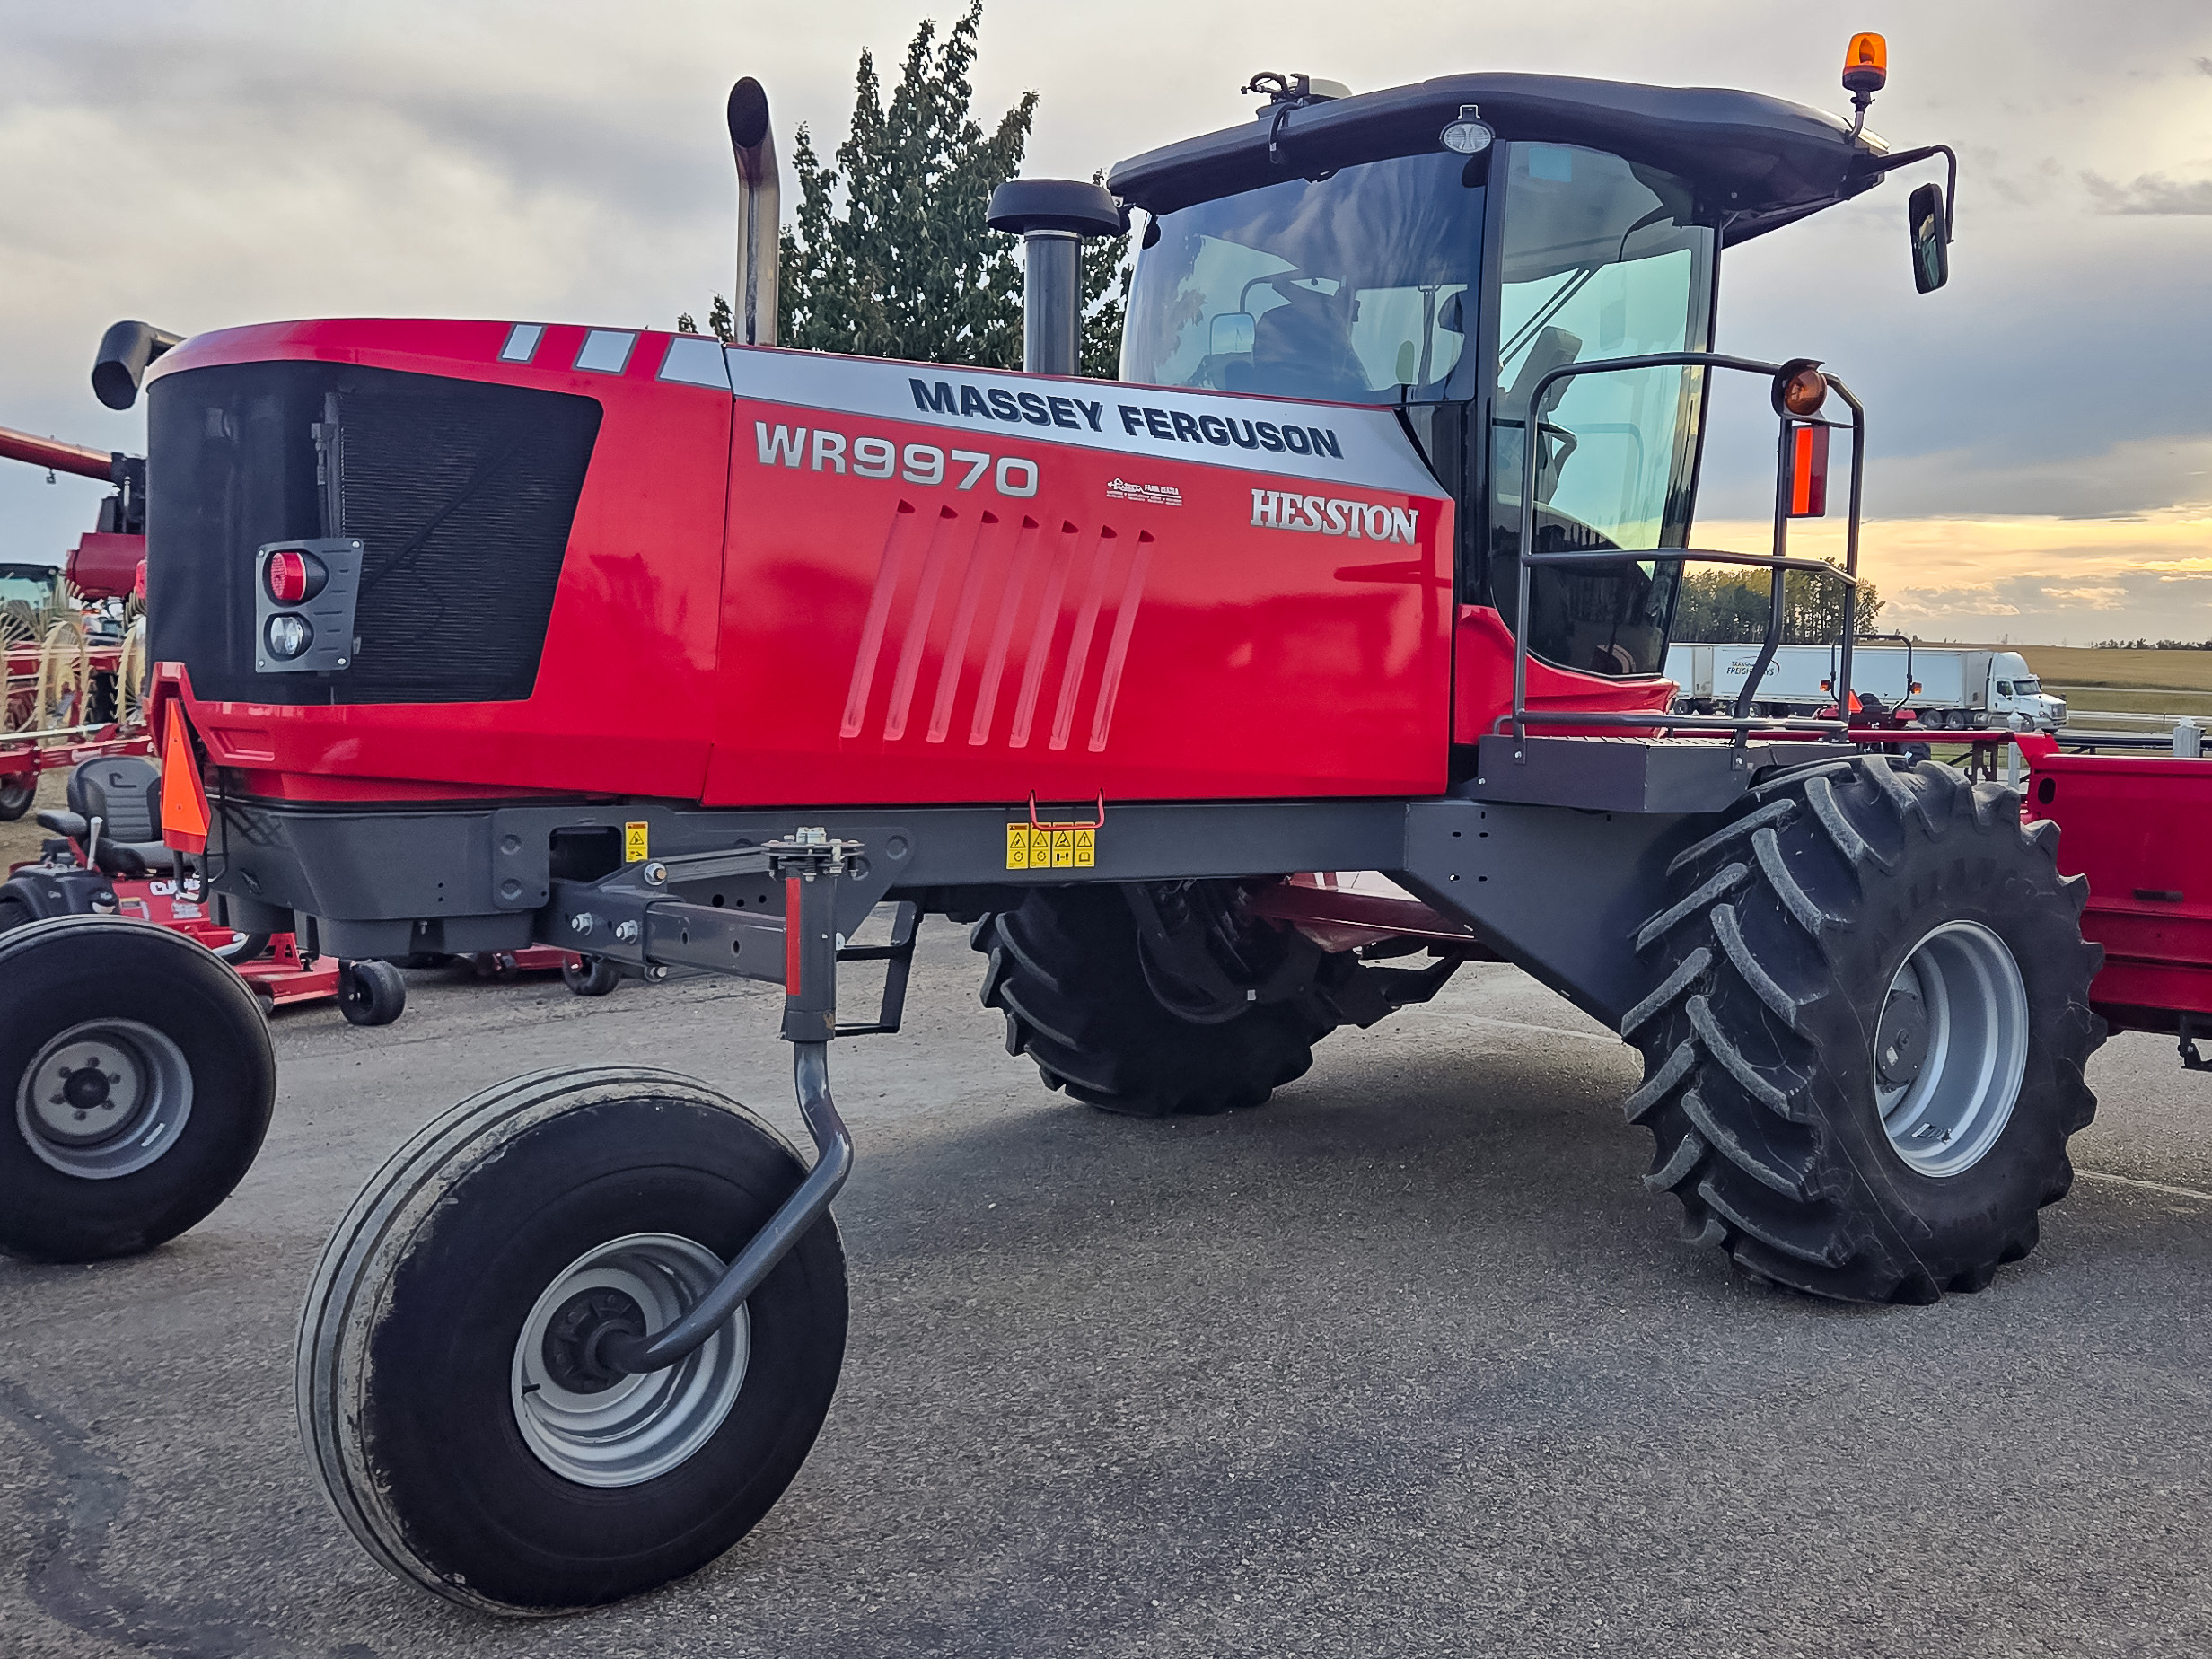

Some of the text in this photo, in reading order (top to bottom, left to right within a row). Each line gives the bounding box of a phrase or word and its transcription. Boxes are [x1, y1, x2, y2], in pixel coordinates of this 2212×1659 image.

[908, 378, 1344, 460] MASSEY FERGUSON
[755, 421, 1040, 498] WR9970
[1251, 488, 1419, 545] HESSTON
[1727, 667, 1774, 675] FREIGHYS
